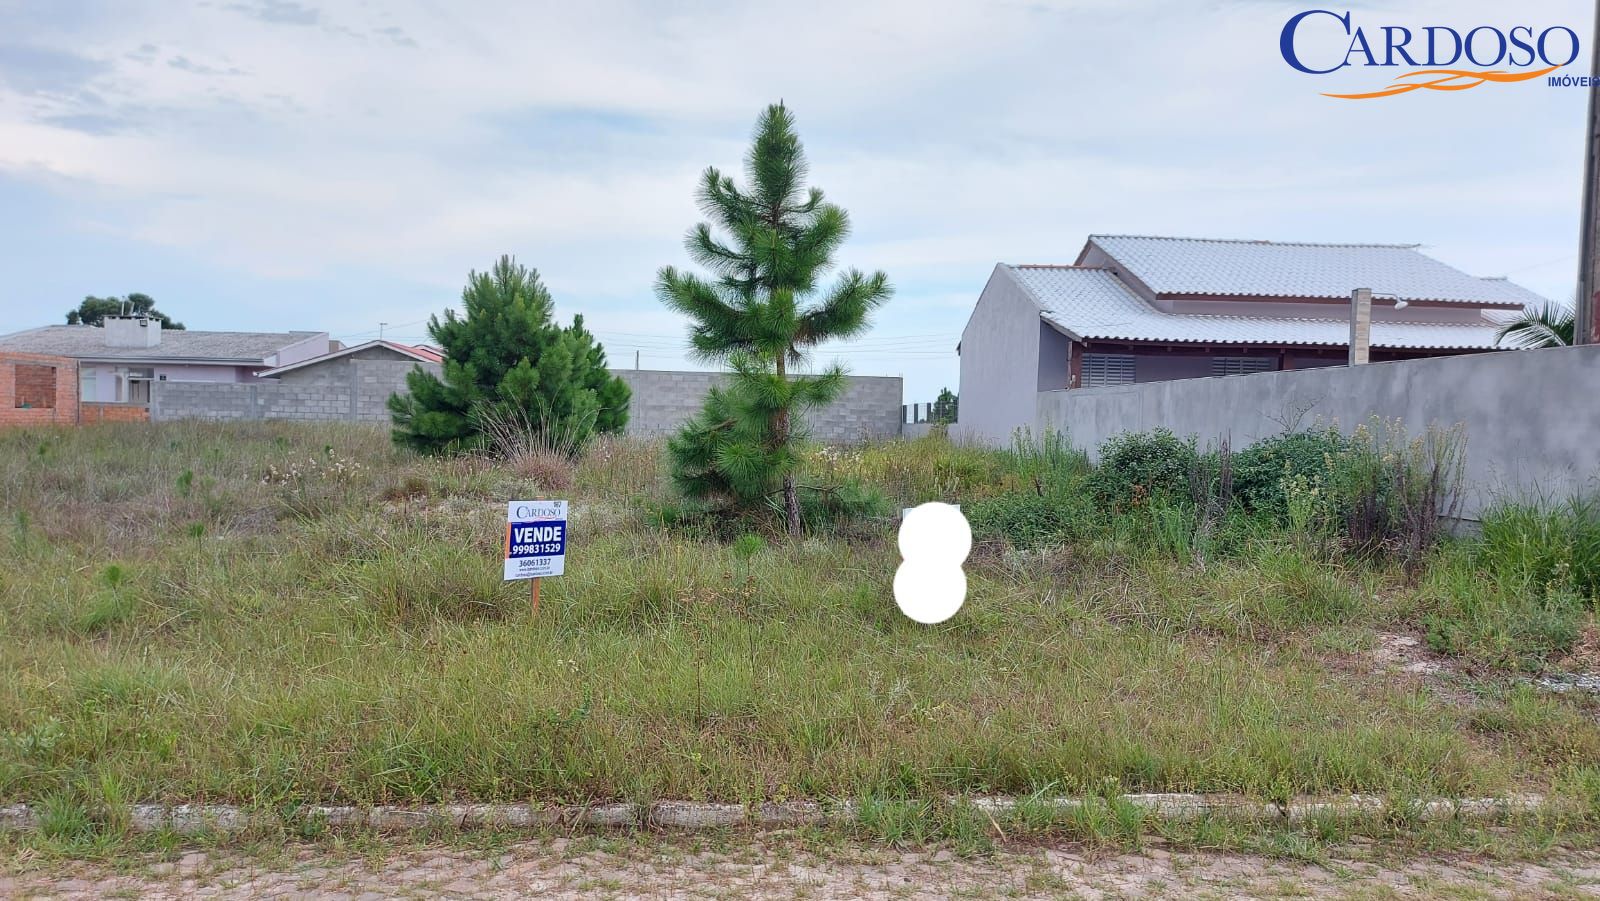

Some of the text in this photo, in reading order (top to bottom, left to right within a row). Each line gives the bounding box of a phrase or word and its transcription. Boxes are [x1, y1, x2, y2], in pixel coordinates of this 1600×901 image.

[516, 505, 561, 519] CARDOSO
[514, 526, 562, 543] VENDE
[519, 558, 551, 567] 36061337
